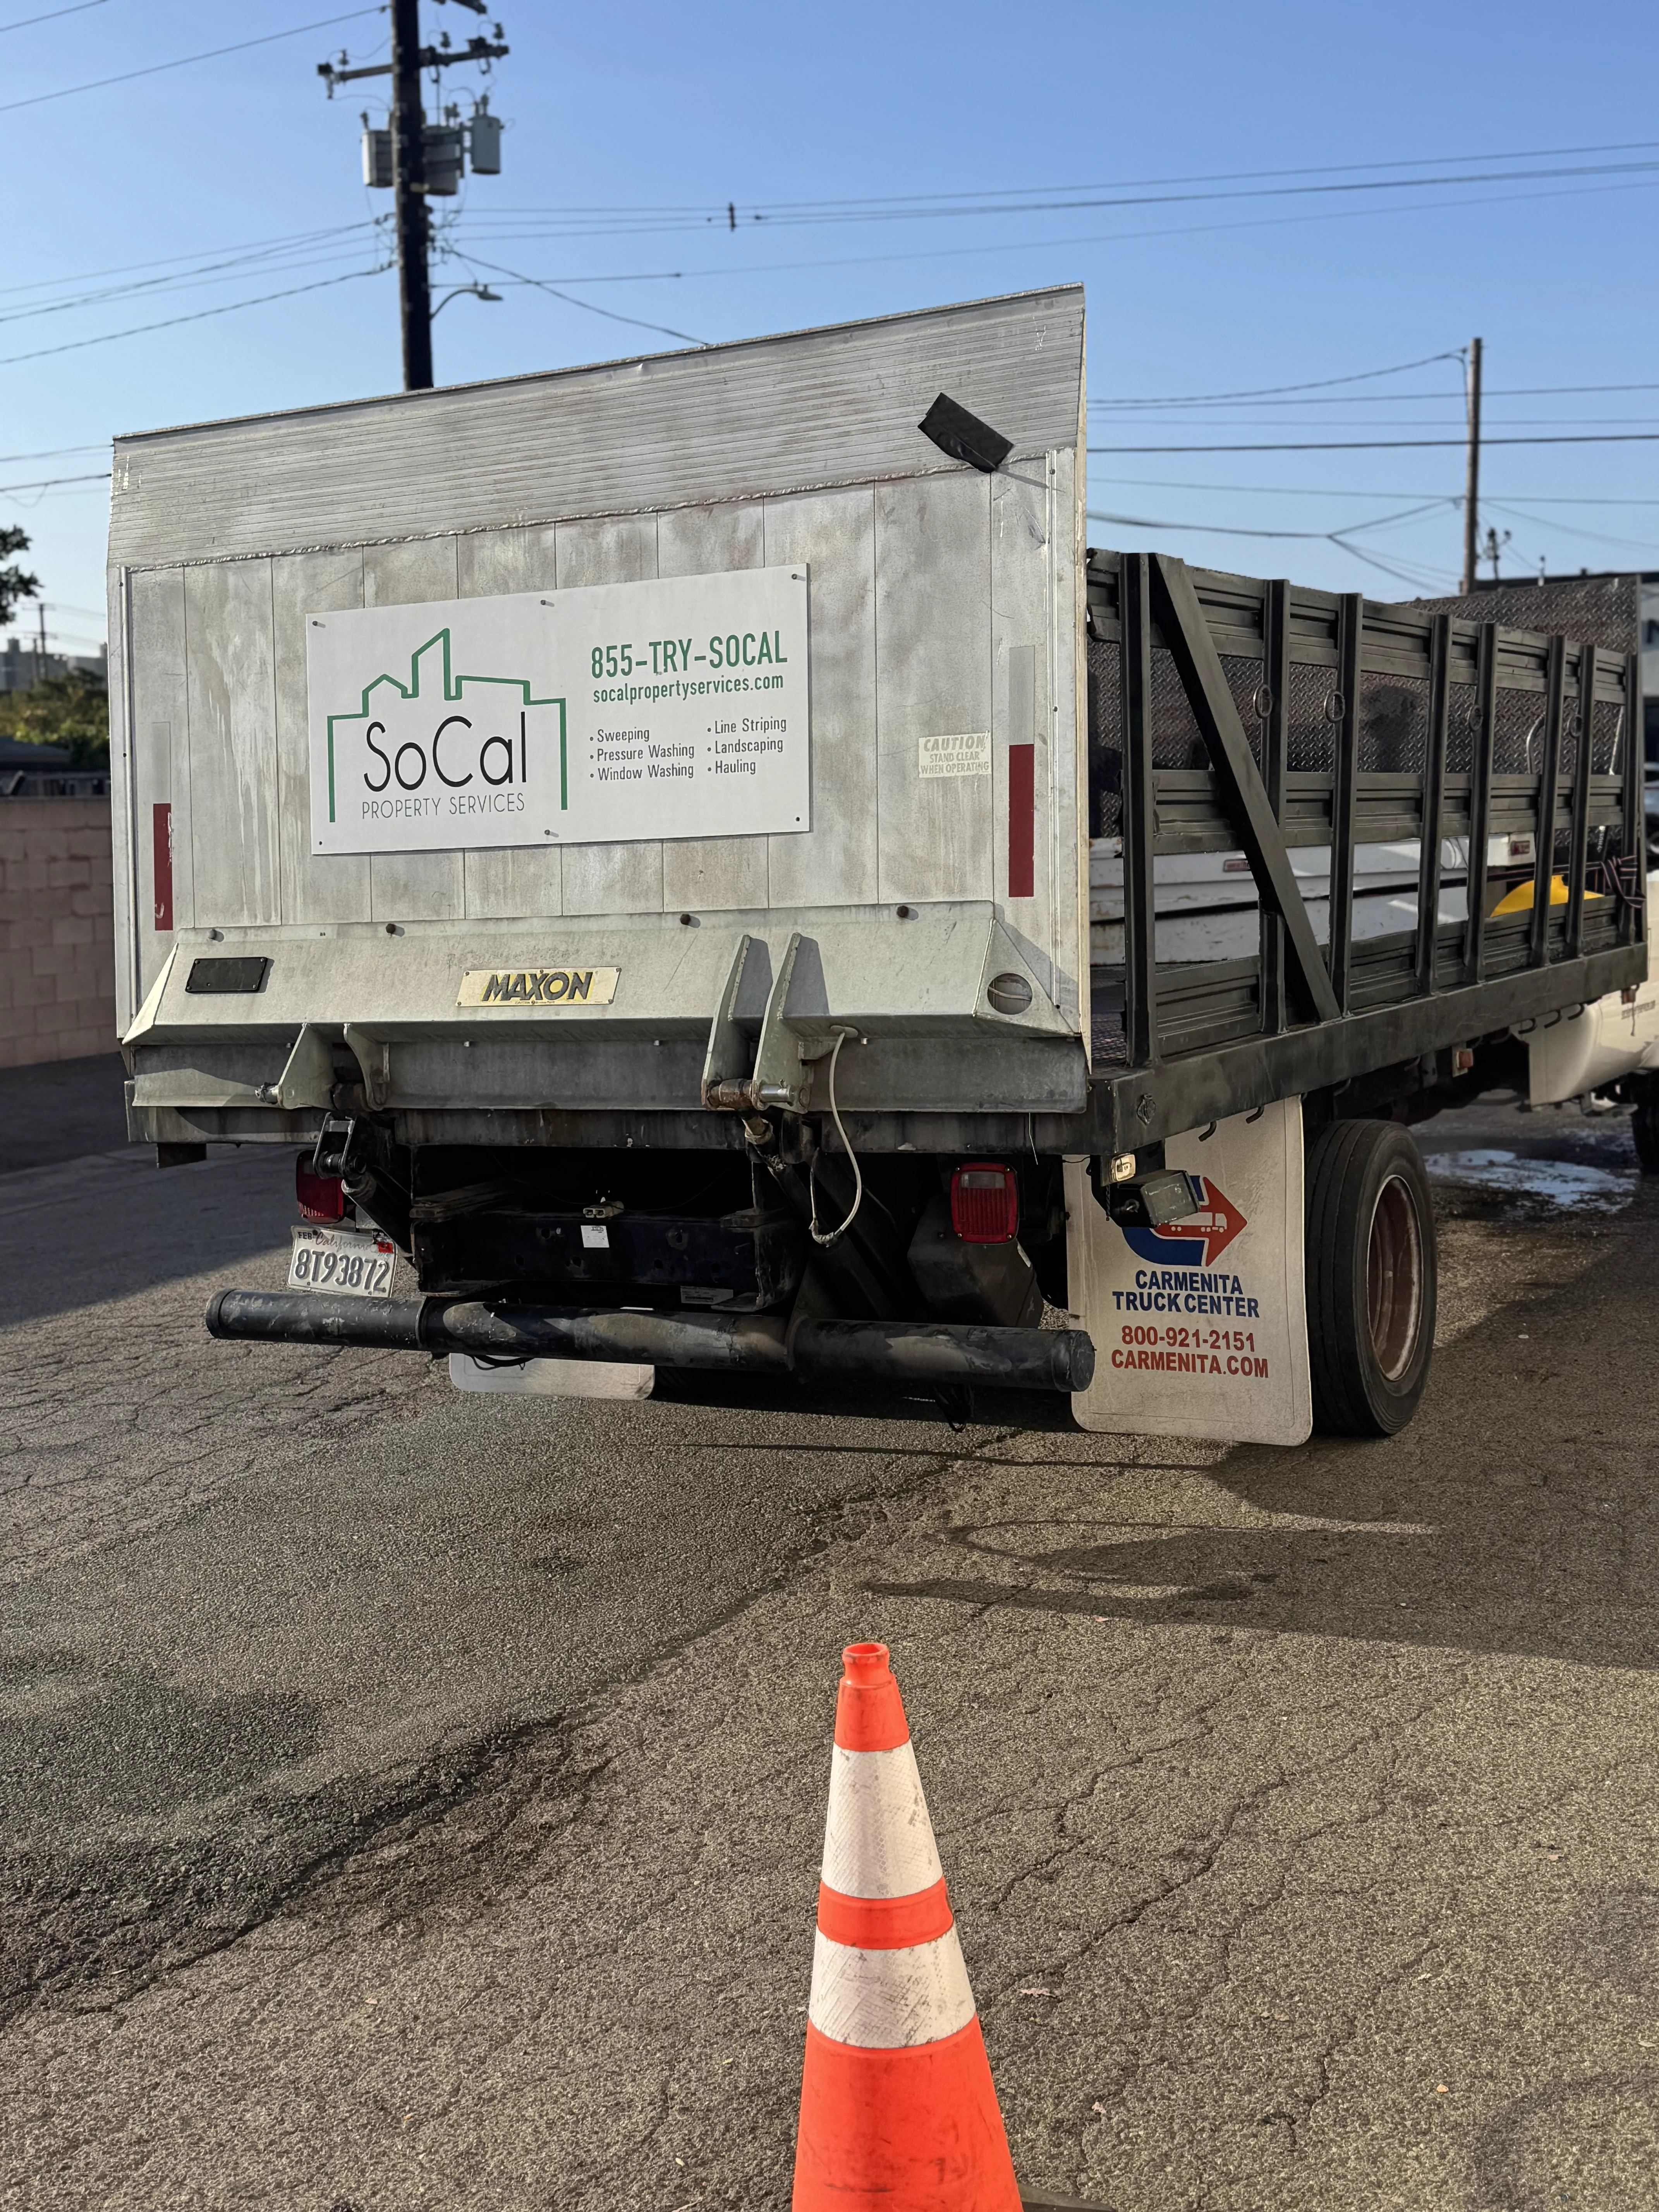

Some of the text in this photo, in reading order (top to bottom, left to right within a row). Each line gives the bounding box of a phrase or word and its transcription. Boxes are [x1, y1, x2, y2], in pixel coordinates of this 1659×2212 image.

[591, 630, 788, 678] 855-TRY-SOCAL
[593, 673, 784, 704] socalpropertyservices.com
[597, 727, 650, 744] Sweeping
[714, 716, 787, 734] Line Striping
[364, 711, 527, 792] SoCal
[597, 744, 695, 761] Pressure Washing
[715, 737, 783, 755] Landscaping
[929, 751, 979, 763] STAND CLEAR
[597, 763, 694, 781] Window Washing
[715, 759, 756, 776] Hauling
[921, 761, 989, 774] WHEN OPERATING
[362, 793, 525, 819] PROPERTY SERVICES
[482, 972, 593, 1002] MAXON
[315, 1231, 372, 1252] California
[295, 1249, 390, 1293] 8T93872
[1135, 1270, 1243, 1295] CARMENITA
[1112, 1291, 1260, 1318] TRUCK CENTER
[1121, 1326, 1255, 1353] 800-921-2151
[1111, 1349, 1269, 1379] CARMENITA.COM
